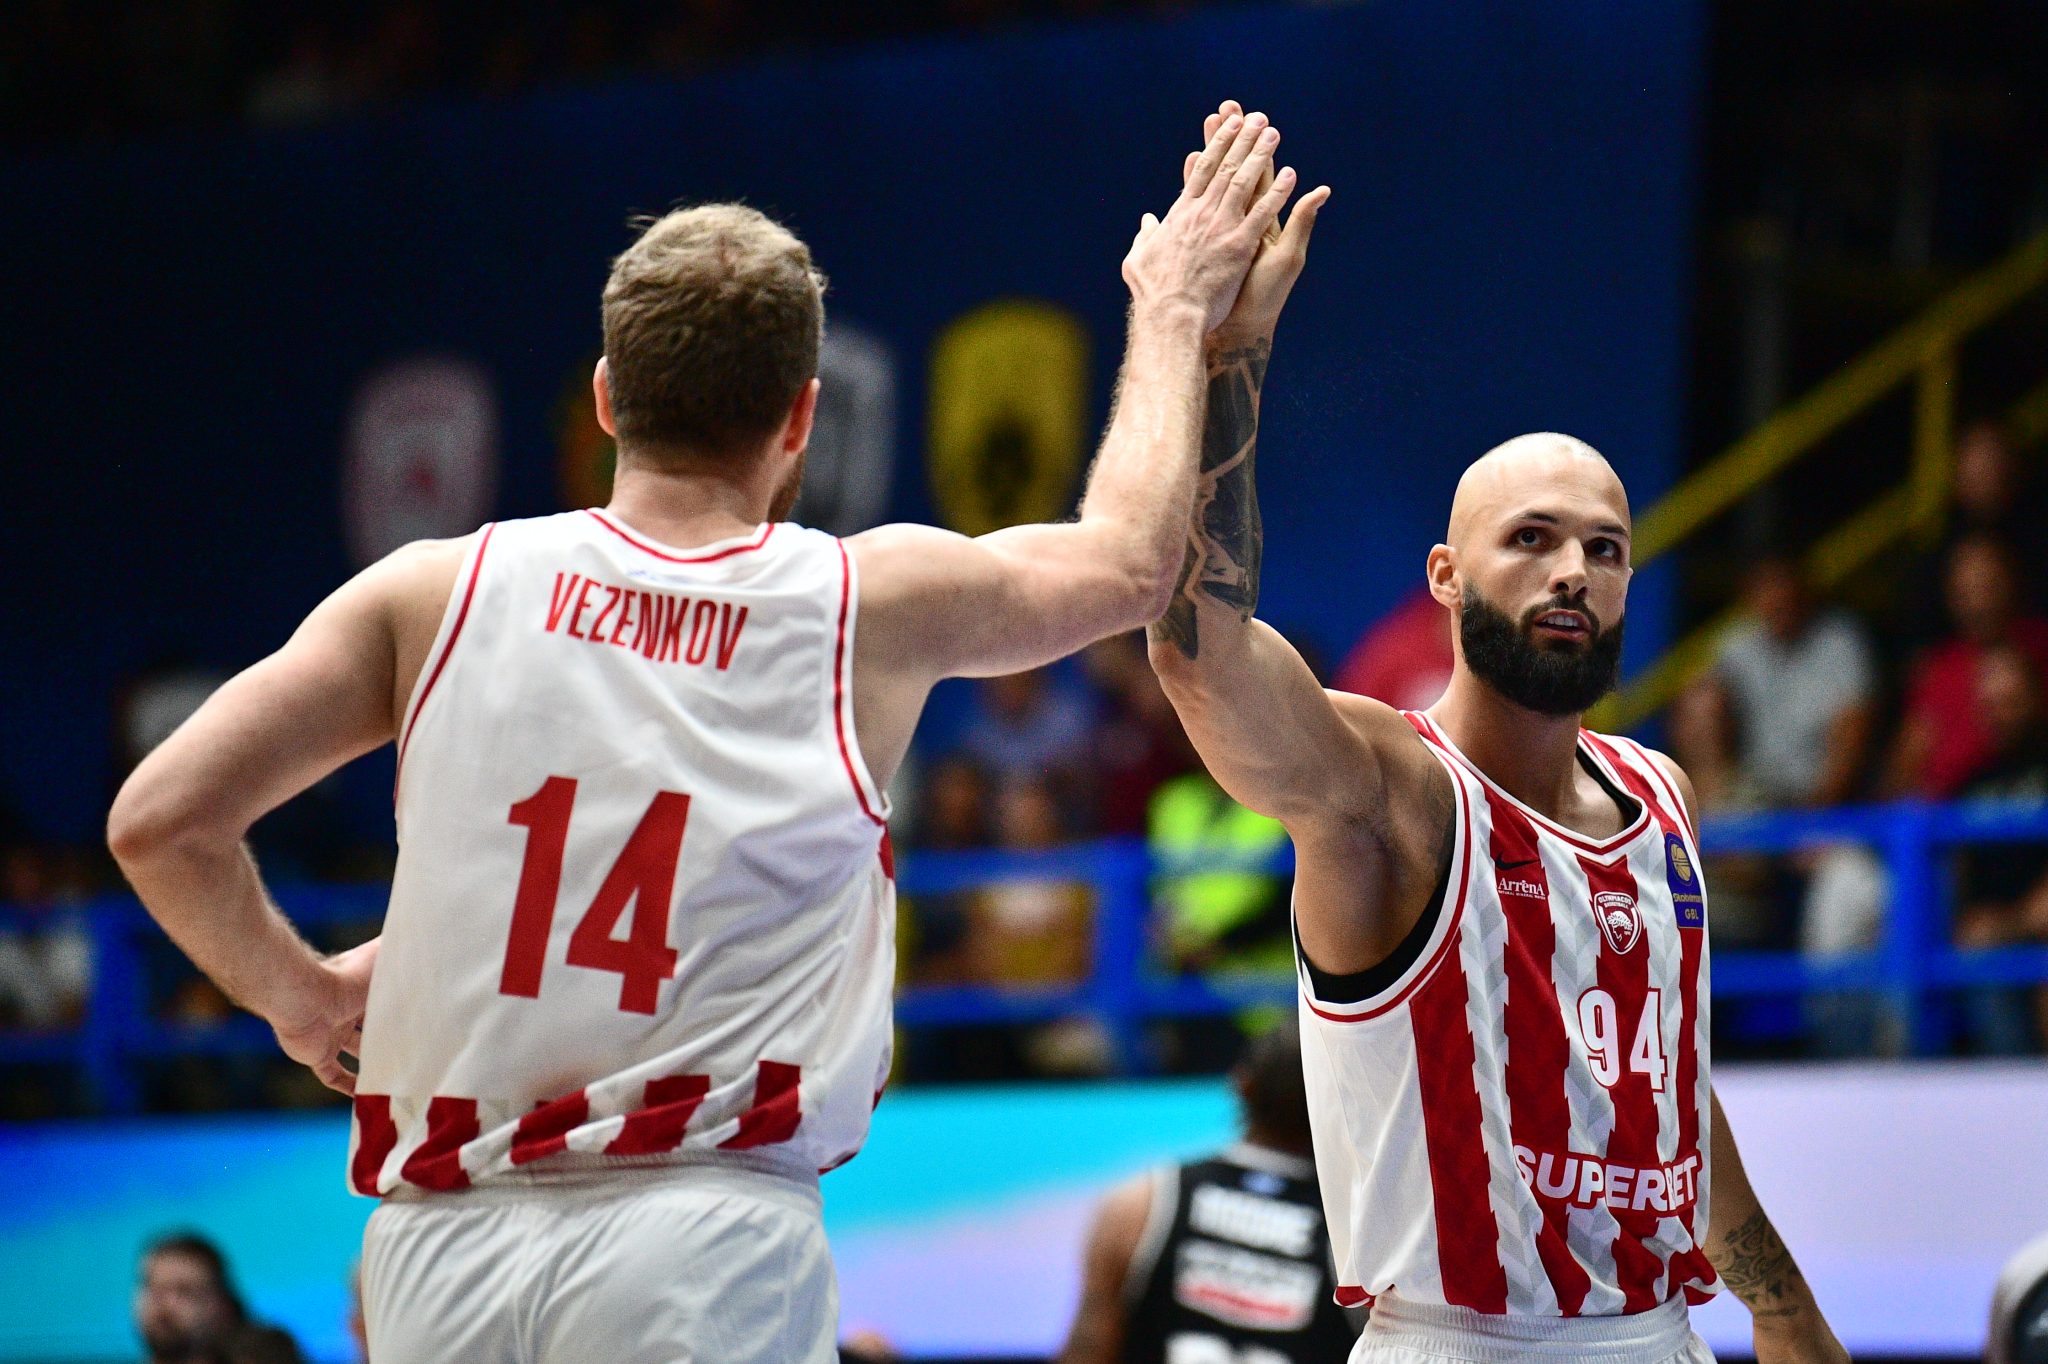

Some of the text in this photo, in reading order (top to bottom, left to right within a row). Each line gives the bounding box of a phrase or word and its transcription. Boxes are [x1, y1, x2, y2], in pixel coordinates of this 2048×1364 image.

[544, 571, 749, 672] VEZENKOV
[498, 775, 692, 1016] 14
[1684, 908, 1700, 920] GBL
[1578, 987, 1667, 1092] 94
